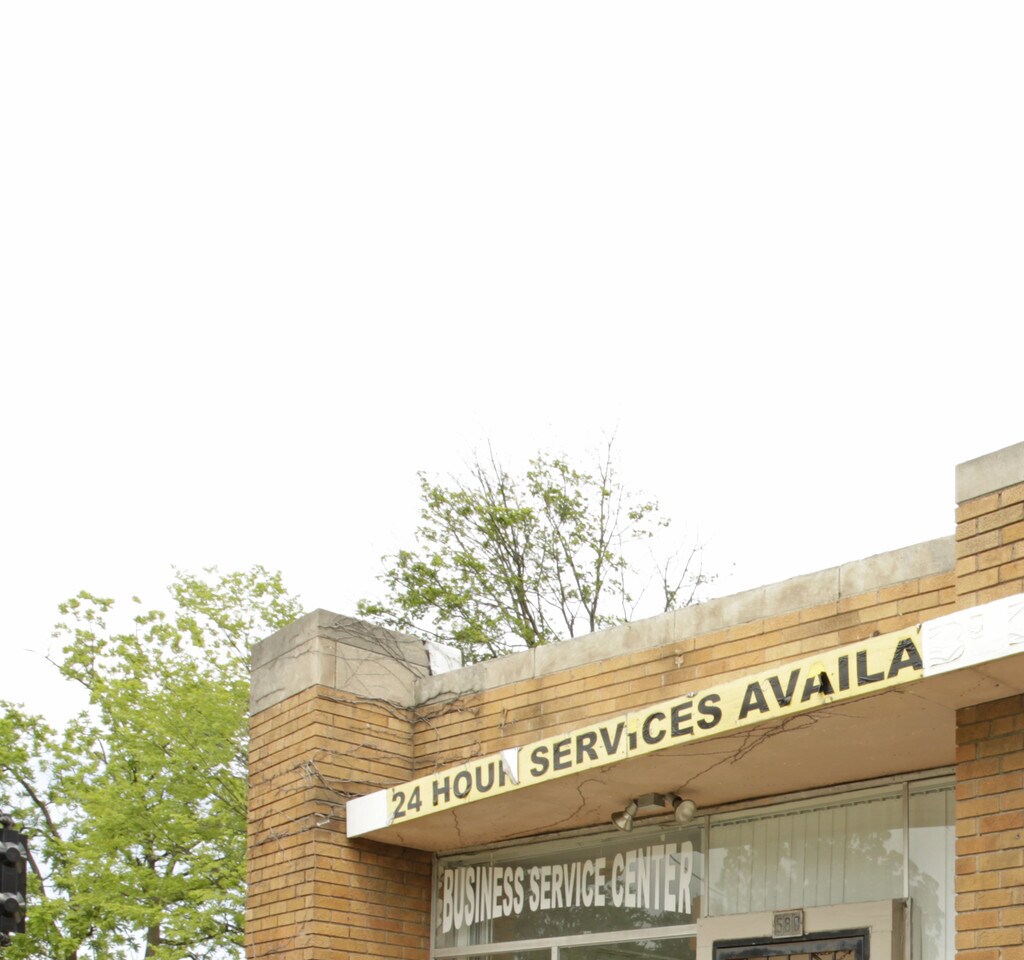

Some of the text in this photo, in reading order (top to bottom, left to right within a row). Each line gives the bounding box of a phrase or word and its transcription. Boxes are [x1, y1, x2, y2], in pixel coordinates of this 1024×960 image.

[391, 786, 423, 818] 24
[529, 693, 722, 777] SERVICES
[738, 637, 924, 720] AVAILA
[442, 841, 693, 934] BUSINESS SERVICE CENTER
